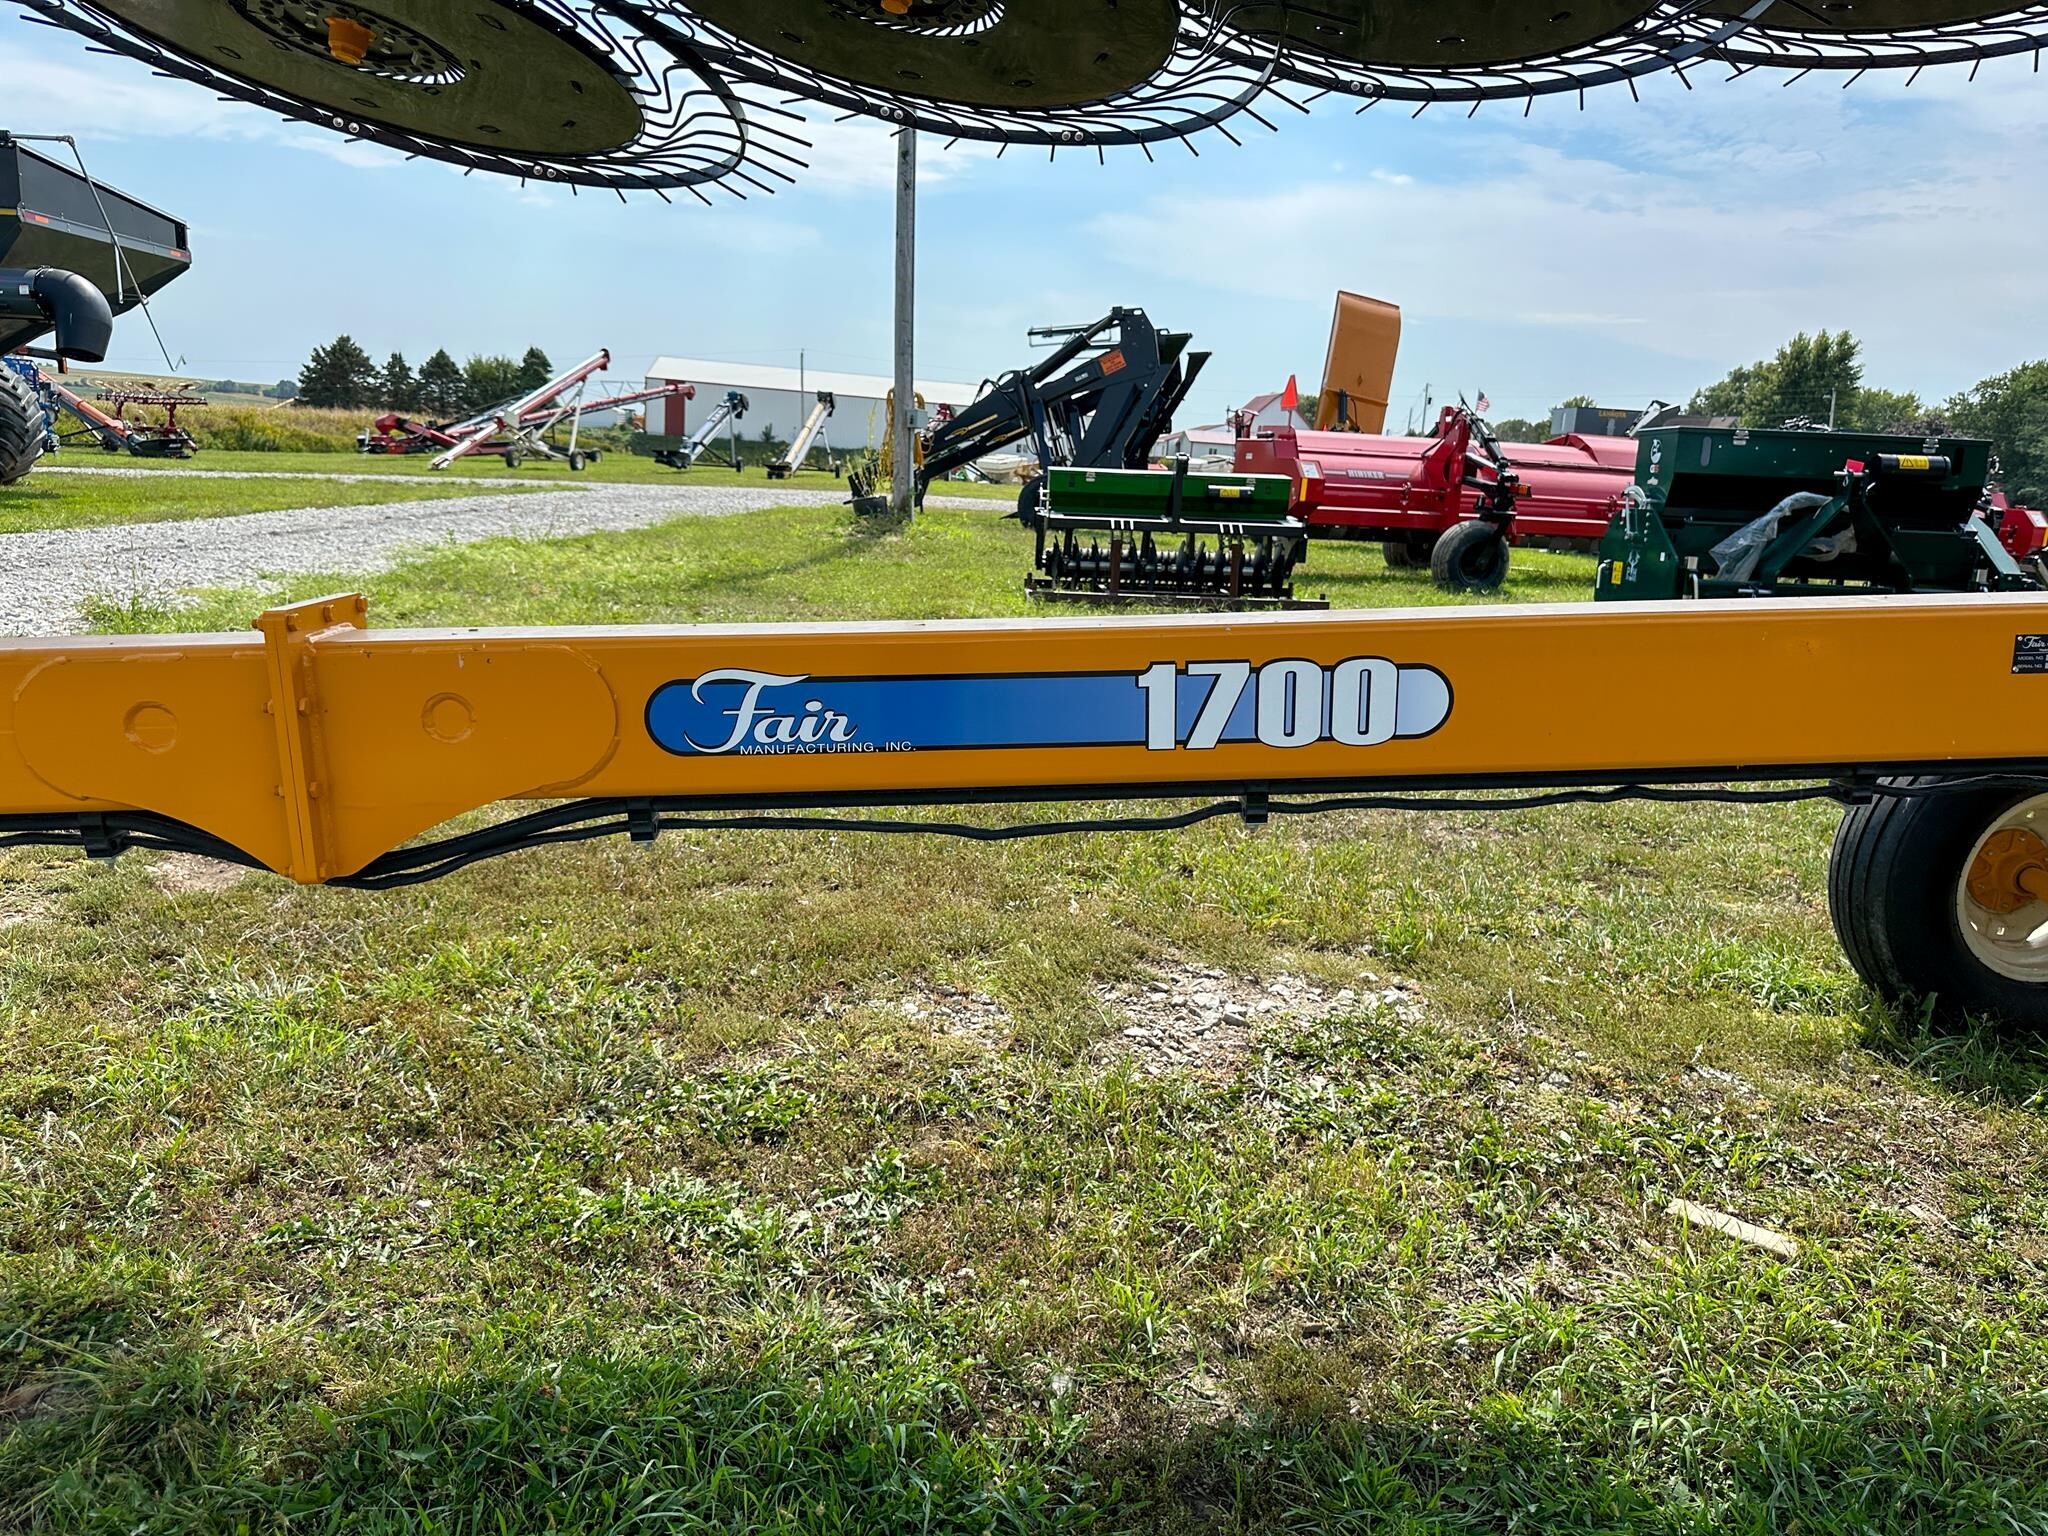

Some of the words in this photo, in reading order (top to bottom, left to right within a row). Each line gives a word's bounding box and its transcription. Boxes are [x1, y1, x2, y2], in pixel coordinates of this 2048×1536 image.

[2022, 636, 2046, 649] Fair
[684, 669, 857, 753] Fair
[1137, 657, 1399, 750] 1700
[740, 742, 879, 755] MANUFACTURING,
[885, 740, 917, 752] INC.
